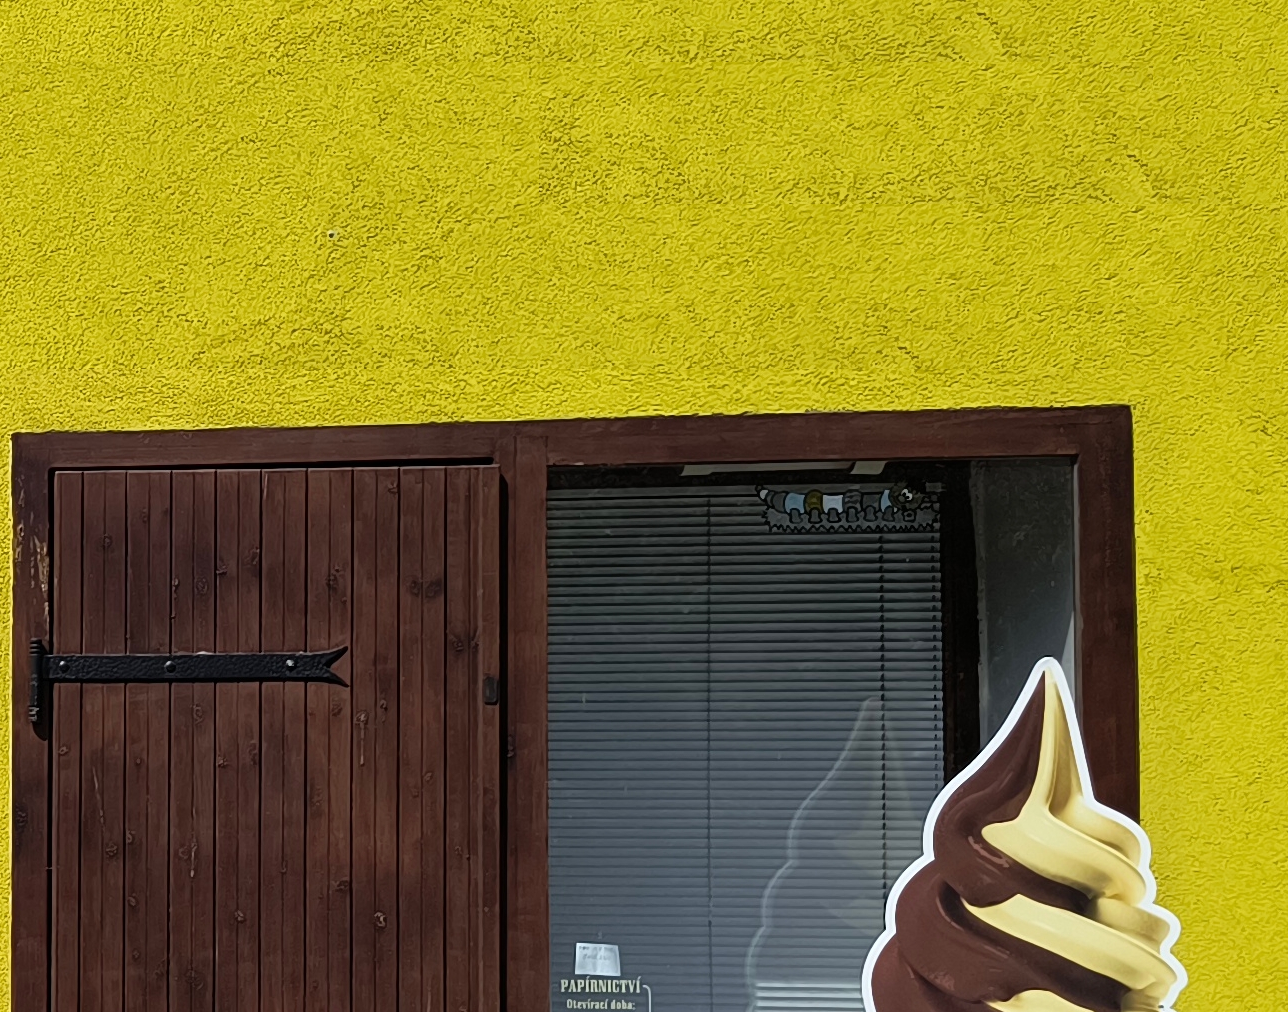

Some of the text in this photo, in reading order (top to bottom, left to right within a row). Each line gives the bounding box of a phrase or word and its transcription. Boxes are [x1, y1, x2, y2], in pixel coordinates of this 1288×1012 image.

[560, 976, 642, 993] PAPÍRNICTVÍ
[566, 998, 636, 1010] Otevírací doba:
